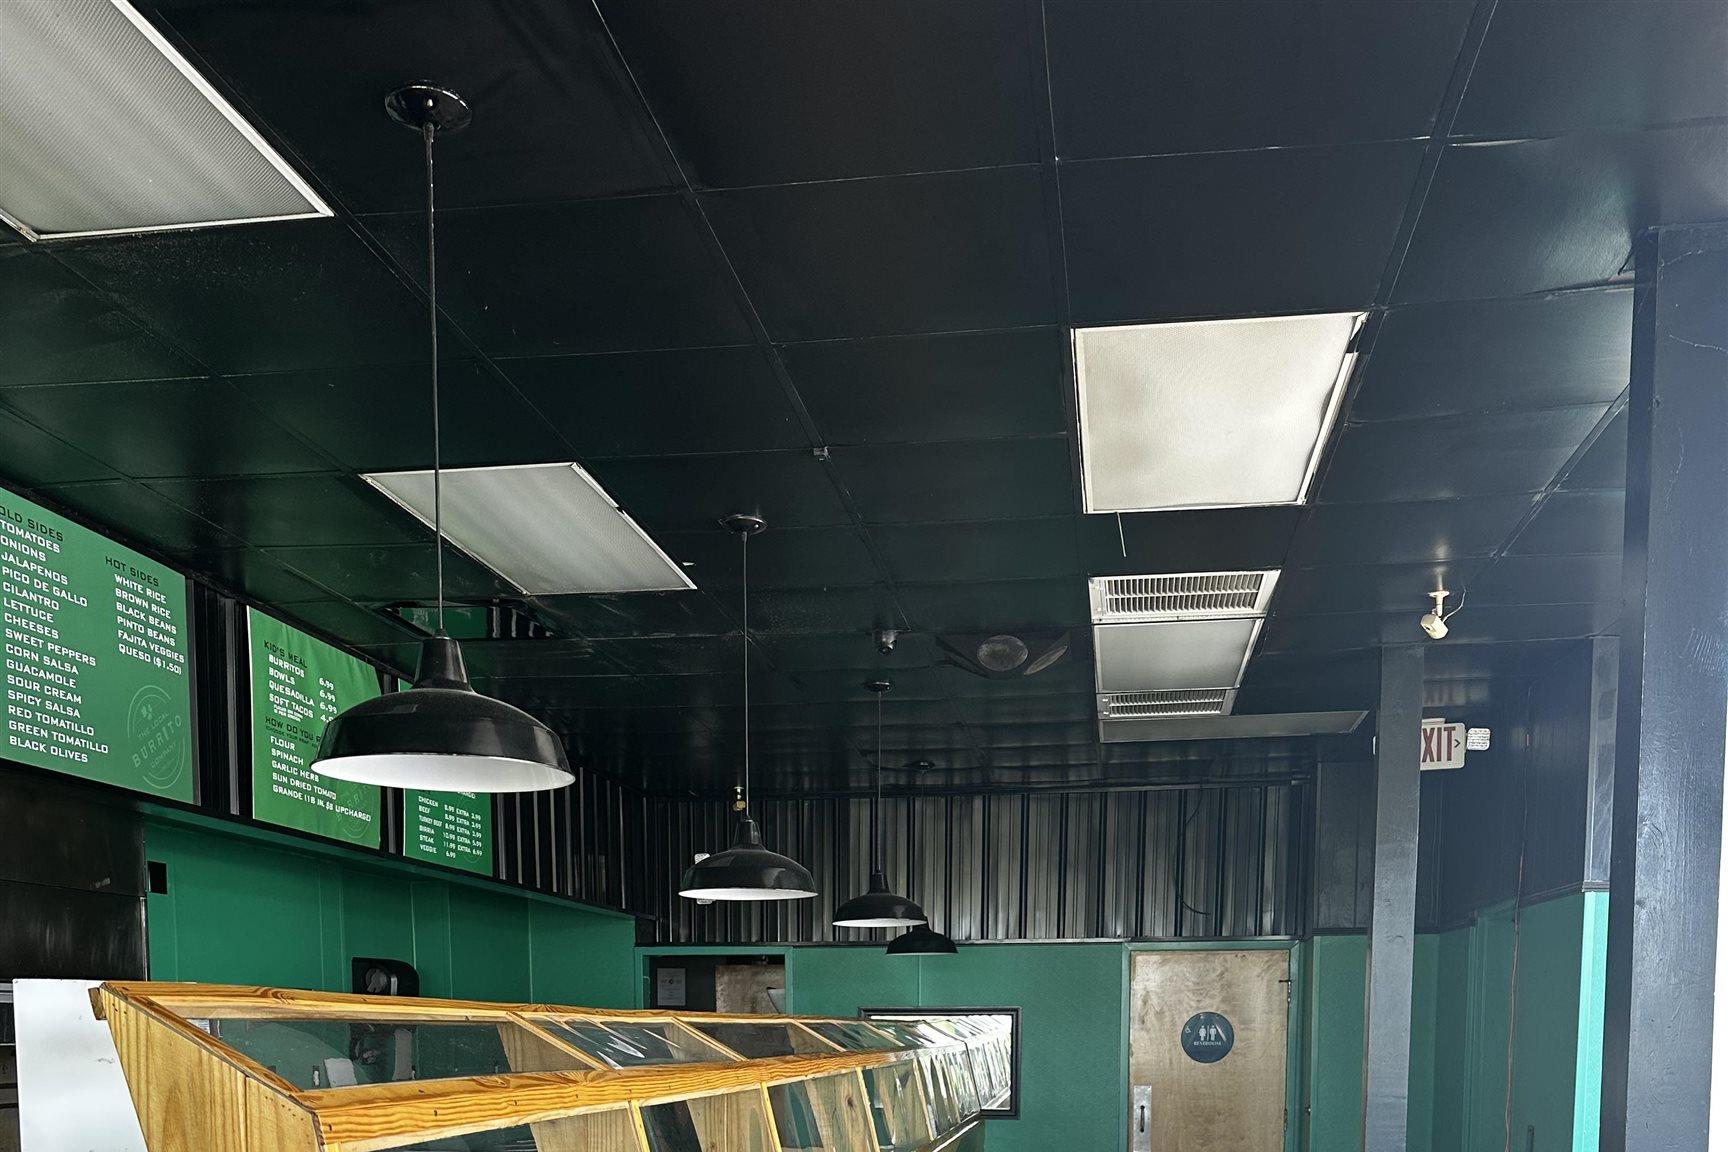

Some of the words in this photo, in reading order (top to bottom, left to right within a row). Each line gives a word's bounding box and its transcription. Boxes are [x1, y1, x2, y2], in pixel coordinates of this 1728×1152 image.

[0, 505, 23, 523] OLD
[27, 518, 64, 542] SIDES
[0, 520, 60, 553] TOMATOES
[0, 535, 46, 561] ONIONS
[1, 552, 68, 585] JALAPENOS
[105, 555, 127, 572] HOT
[130, 567, 159, 587] SIDES
[2, 566, 29, 585] PICO
[33, 578, 49, 592] DE
[53, 586, 87, 607] GALLO
[3, 581, 59, 610] CILANTRO
[114, 573, 144, 594] WHITE
[146, 588, 167, 604] RICE
[4, 597, 54, 623] LETTUCE
[115, 587, 149, 609] BROWN
[151, 603, 171, 619] RICE
[4, 612, 59, 639] CHEESES
[116, 601, 147, 622] BLACK
[148, 615, 177, 635] BEANS
[117, 615, 145, 634] PINTO
[147, 627, 176, 647] BEANS
[5, 628, 44, 648] SWEET
[47, 642, 96, 666] PEPPERS
[5, 643, 39, 662] CORN
[43, 655, 79, 675] SALSA
[118, 629, 147, 649] FAJITA
[149, 641, 185, 664] VEGGIES
[118, 643, 151, 663] QUESO
[153, 656, 182, 675] ($1.50)
[264, 640, 285, 657] KID'S
[6, 658, 76, 688] GUACAMOLE
[268, 654, 304, 677] BURRITOS
[268, 666, 295, 685] BOWLS
[319, 677, 334, 691] 6.99
[7, 674, 41, 692] SOUR
[44, 685, 82, 704] CREAM
[268, 679, 315, 707] QUESADILLA
[319, 689, 336, 703] 6.99
[7, 689, 41, 706] SPICY
[45, 700, 81, 719] SALSA
[268, 693, 290, 708] SOFT
[291, 701, 314, 719] TACOS
[319, 701, 337, 714] 6.99
[8, 704, 32, 719] RED
[35, 711, 94, 736] TOMATILLO
[265, 716, 284, 729] HOW
[286, 724, 298, 735] DO
[299, 729, 314, 741] YOU
[8, 719, 48, 738] GREEN
[51, 730, 109, 754] TOMATILLO
[9, 735, 47, 753] BLACK
[50, 745, 88, 763] OLIVES
[132, 715, 182, 768] BURRITO
[270, 735, 296, 751] FLOUR
[1421, 726, 1456, 763] XIT
[271, 748, 304, 766] SPINACH
[271, 760, 298, 776] GARLIC
[299, 770, 319, 783] HERB
[272, 772, 288, 784] SUN
[289, 778, 312, 792] DRIED
[313, 785, 337, 800] TOMATO
[272, 784, 303, 800] GRANDE
[418, 796, 438, 807] CHICKEN
[456, 808, 469, 817] EXTRA
[419, 805, 430, 814] BEEF
[456, 817, 470, 825] EXTRA
[420, 834, 434, 843] STEAK
[458, 845, 471, 853] EXTRA
[457, 826, 470, 835] EXTRA
[457, 836, 471, 844] EXTRA
[420, 844, 437, 853] VEGGIE
